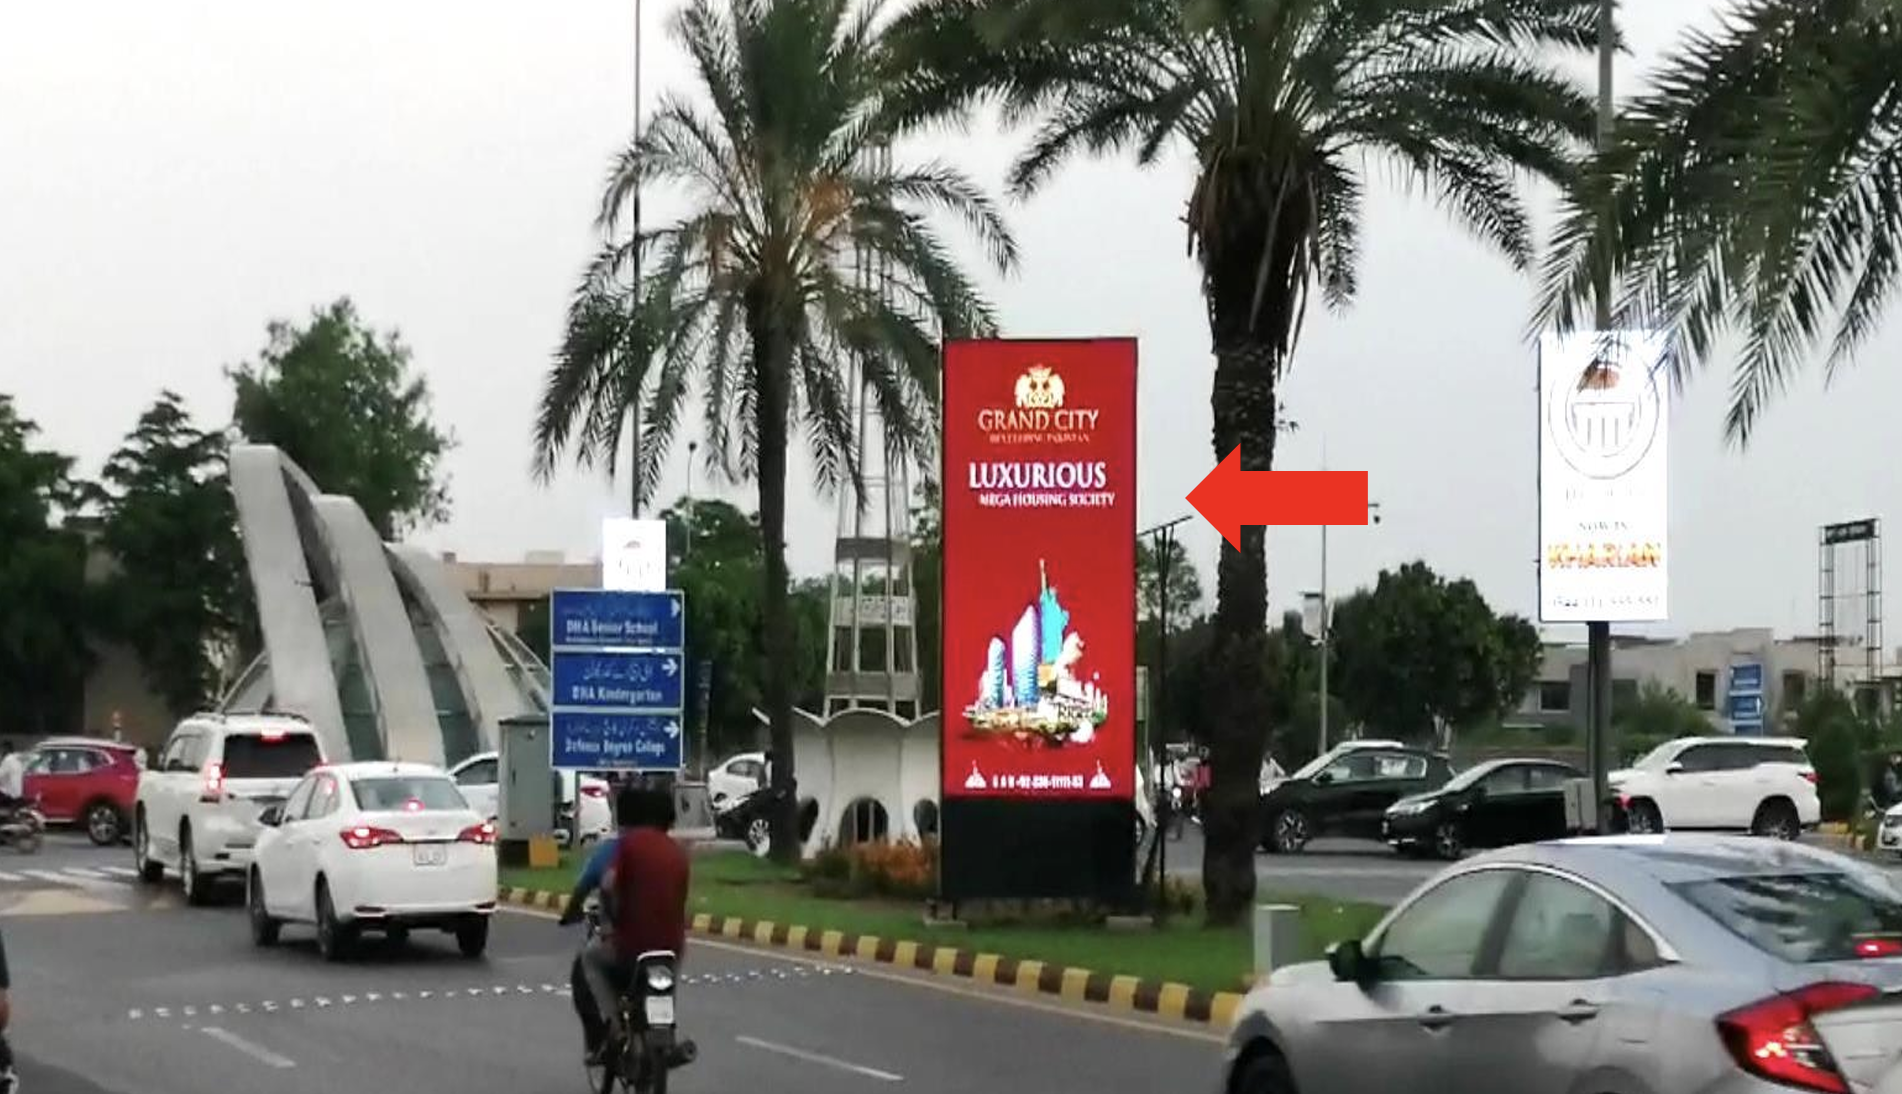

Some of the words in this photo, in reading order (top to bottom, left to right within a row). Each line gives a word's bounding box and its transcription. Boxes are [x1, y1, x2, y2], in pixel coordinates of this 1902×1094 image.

[978, 409, 1050, 431] GRAND
[1054, 409, 1099, 431] CITY
[968, 461, 1107, 488] LUXURIOUS
[979, 492, 1013, 507] MEGA
[1013, 492, 1067, 507] HOUSING
[1069, 491, 1115, 507] SOCIETY
[1547, 542, 1661, 568] KHARIAN
